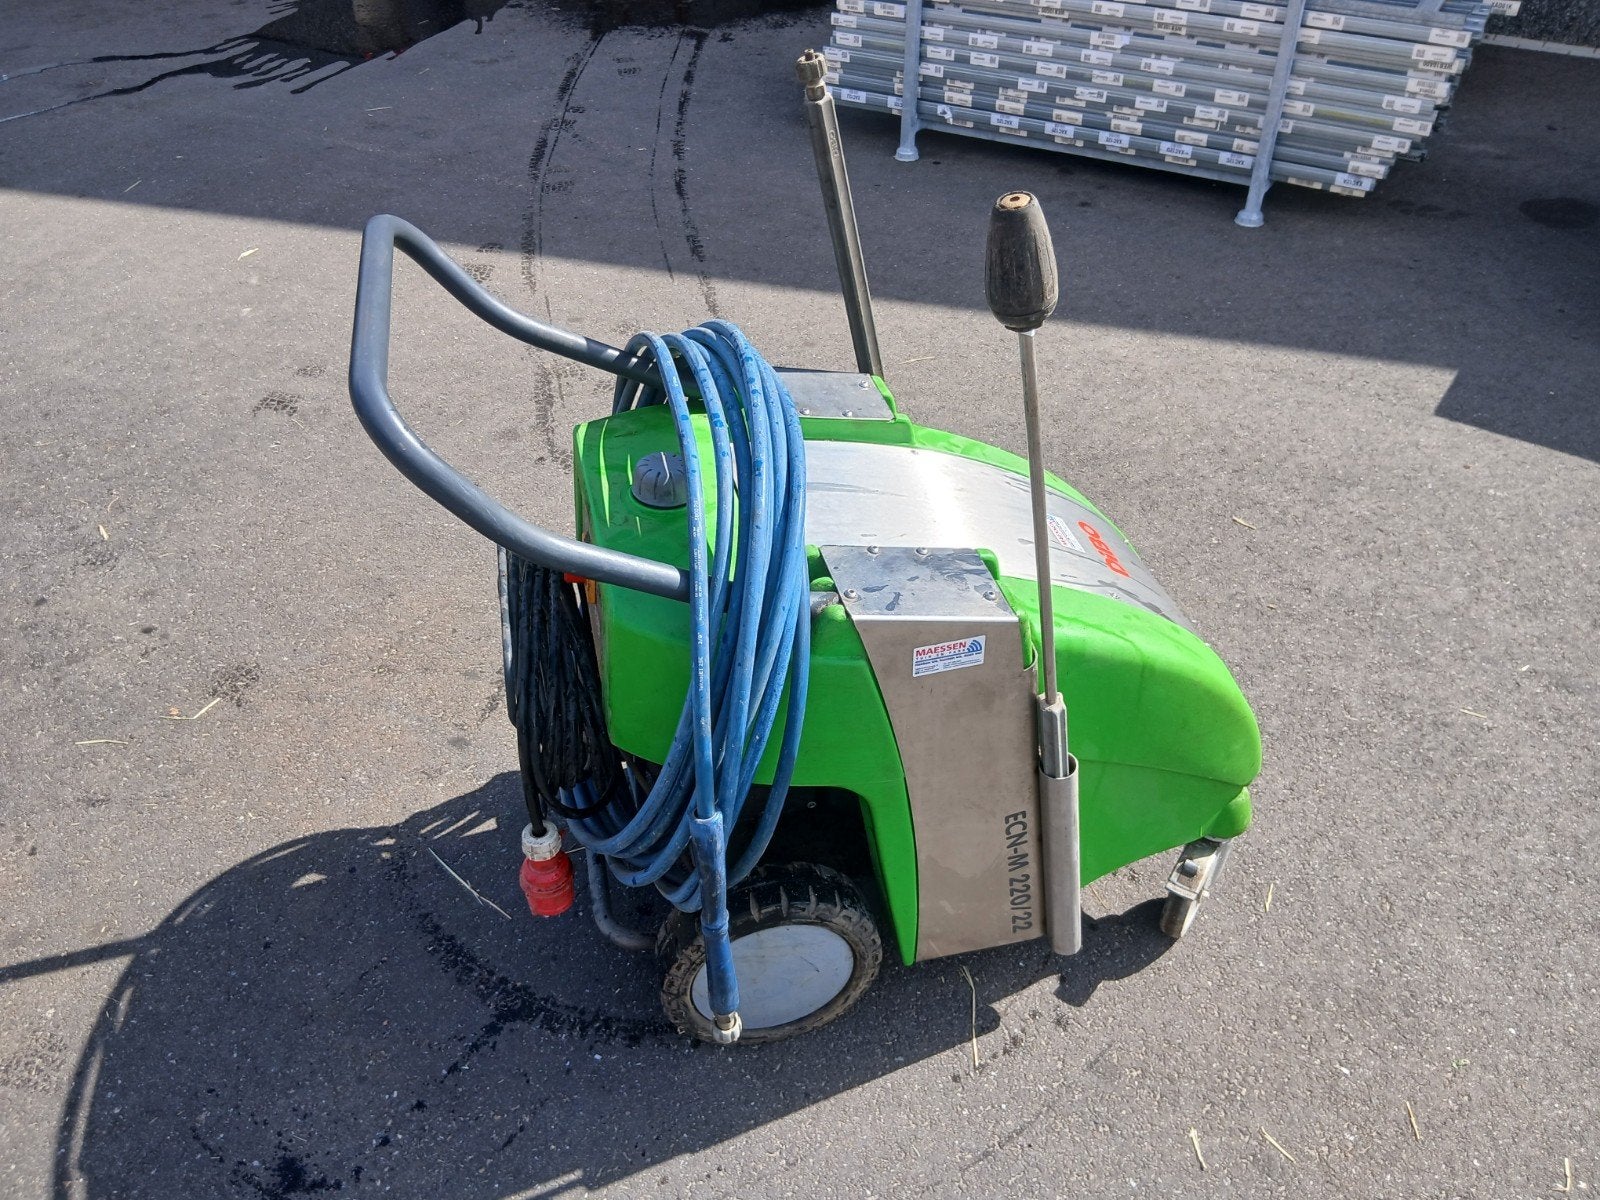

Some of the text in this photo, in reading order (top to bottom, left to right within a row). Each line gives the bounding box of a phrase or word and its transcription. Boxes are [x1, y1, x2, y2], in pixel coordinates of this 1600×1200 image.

[916, 641, 967, 656] MAESSEN
[1005, 811, 1032, 934] ECN-M 220/22
